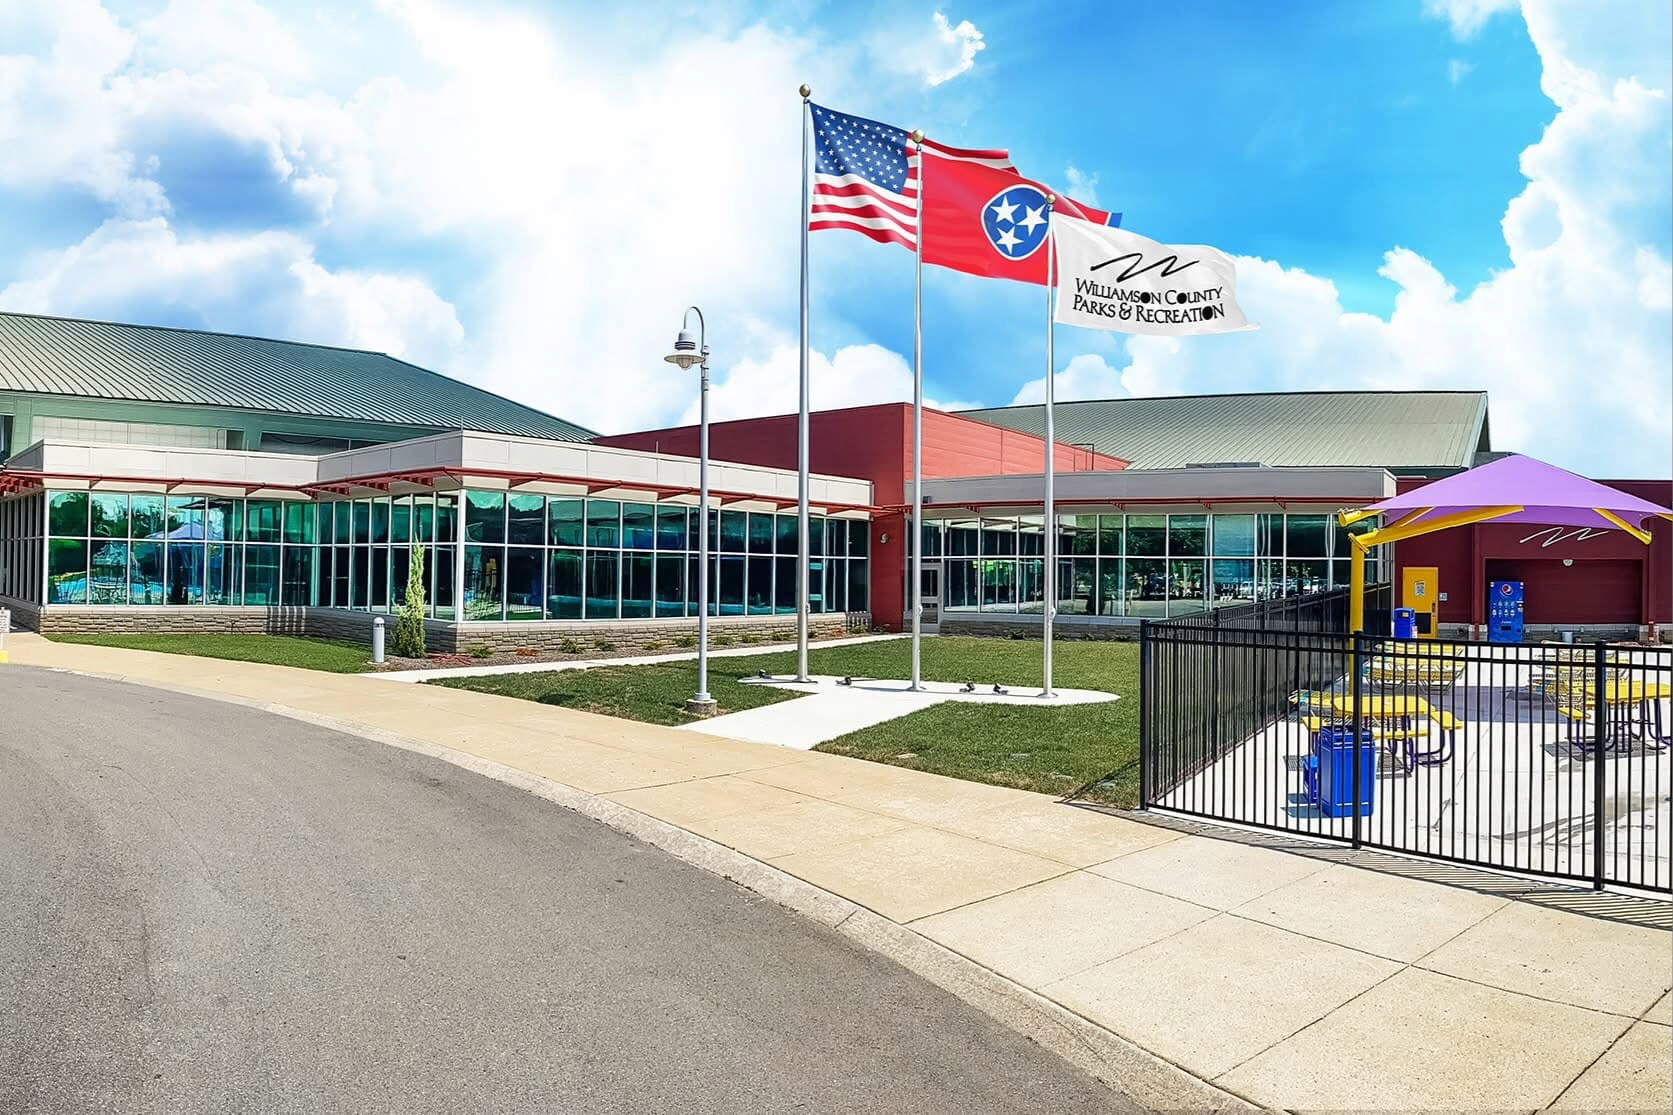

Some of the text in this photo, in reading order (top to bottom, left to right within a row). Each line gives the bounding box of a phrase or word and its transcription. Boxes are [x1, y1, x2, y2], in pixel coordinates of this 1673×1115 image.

[1165, 286, 1223, 305] COUNTY
[1072, 294, 1225, 323] PARKS & RECREATION
